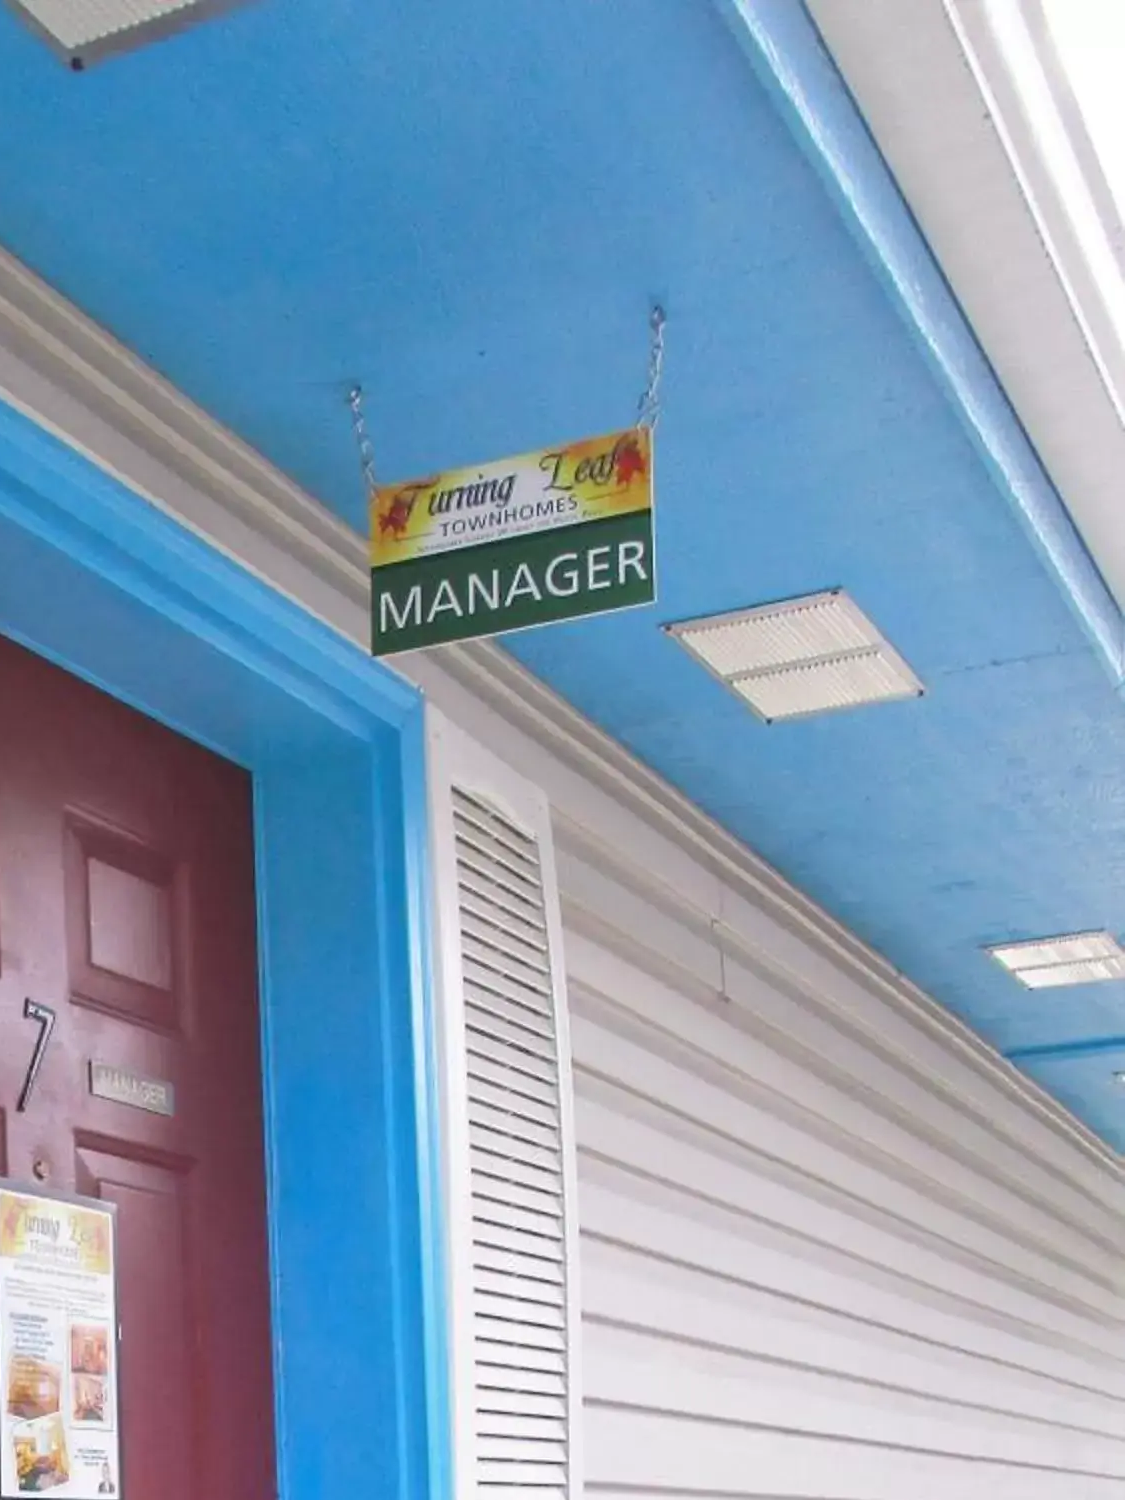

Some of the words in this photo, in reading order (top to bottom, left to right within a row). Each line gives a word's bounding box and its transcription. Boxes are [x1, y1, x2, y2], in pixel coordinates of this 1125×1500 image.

[396, 474, 517, 521] Turning
[539, 438, 632, 491] Leaf
[439, 496, 579, 538] TOWNHOMES
[379, 540, 648, 634] MANAGER
[16, 997, 56, 1112] 7
